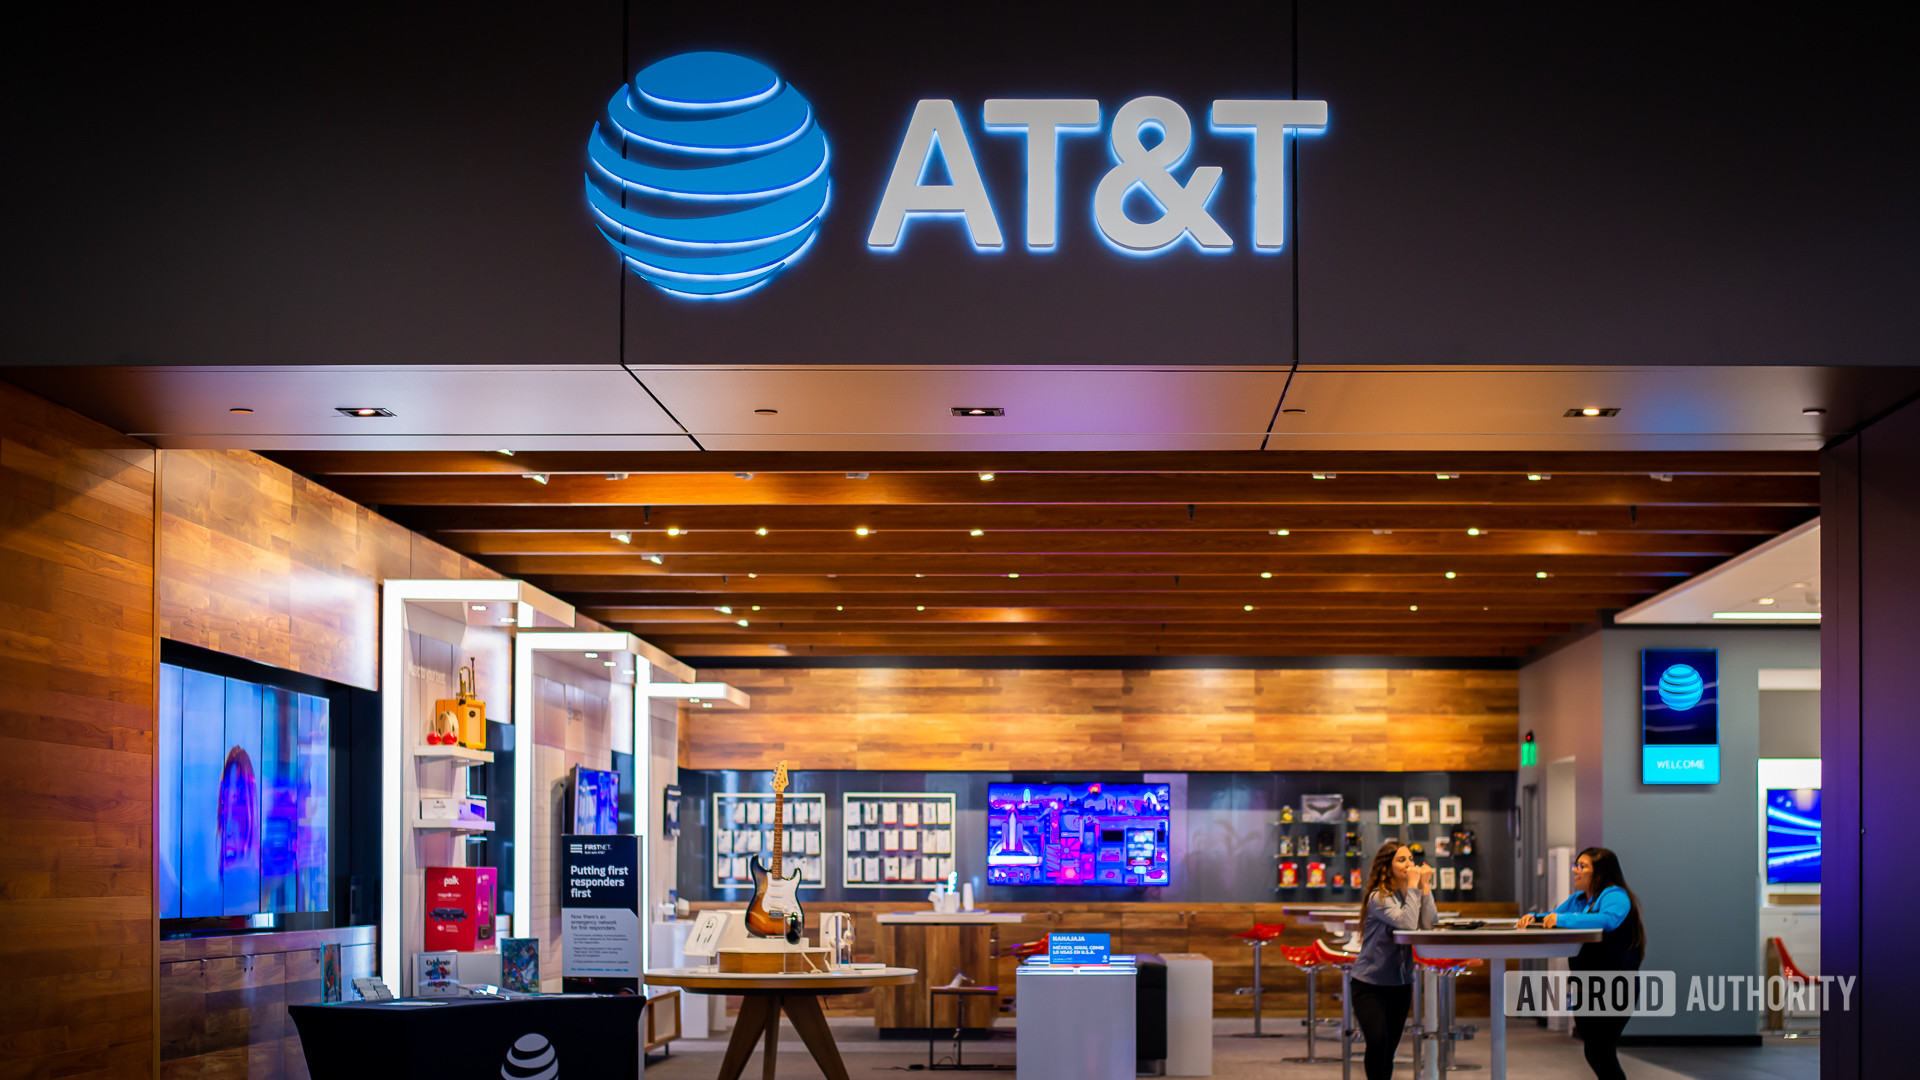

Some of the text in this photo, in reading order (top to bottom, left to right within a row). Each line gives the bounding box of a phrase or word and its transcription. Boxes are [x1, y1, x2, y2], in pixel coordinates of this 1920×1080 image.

[867, 95, 1328, 250] AT&T
[1657, 759, 1705, 770] WELCOME
[570, 865, 629, 877] Putting first
[443, 875, 459, 887] polk
[570, 876, 625, 888] responders
[570, 887, 592, 898] first
